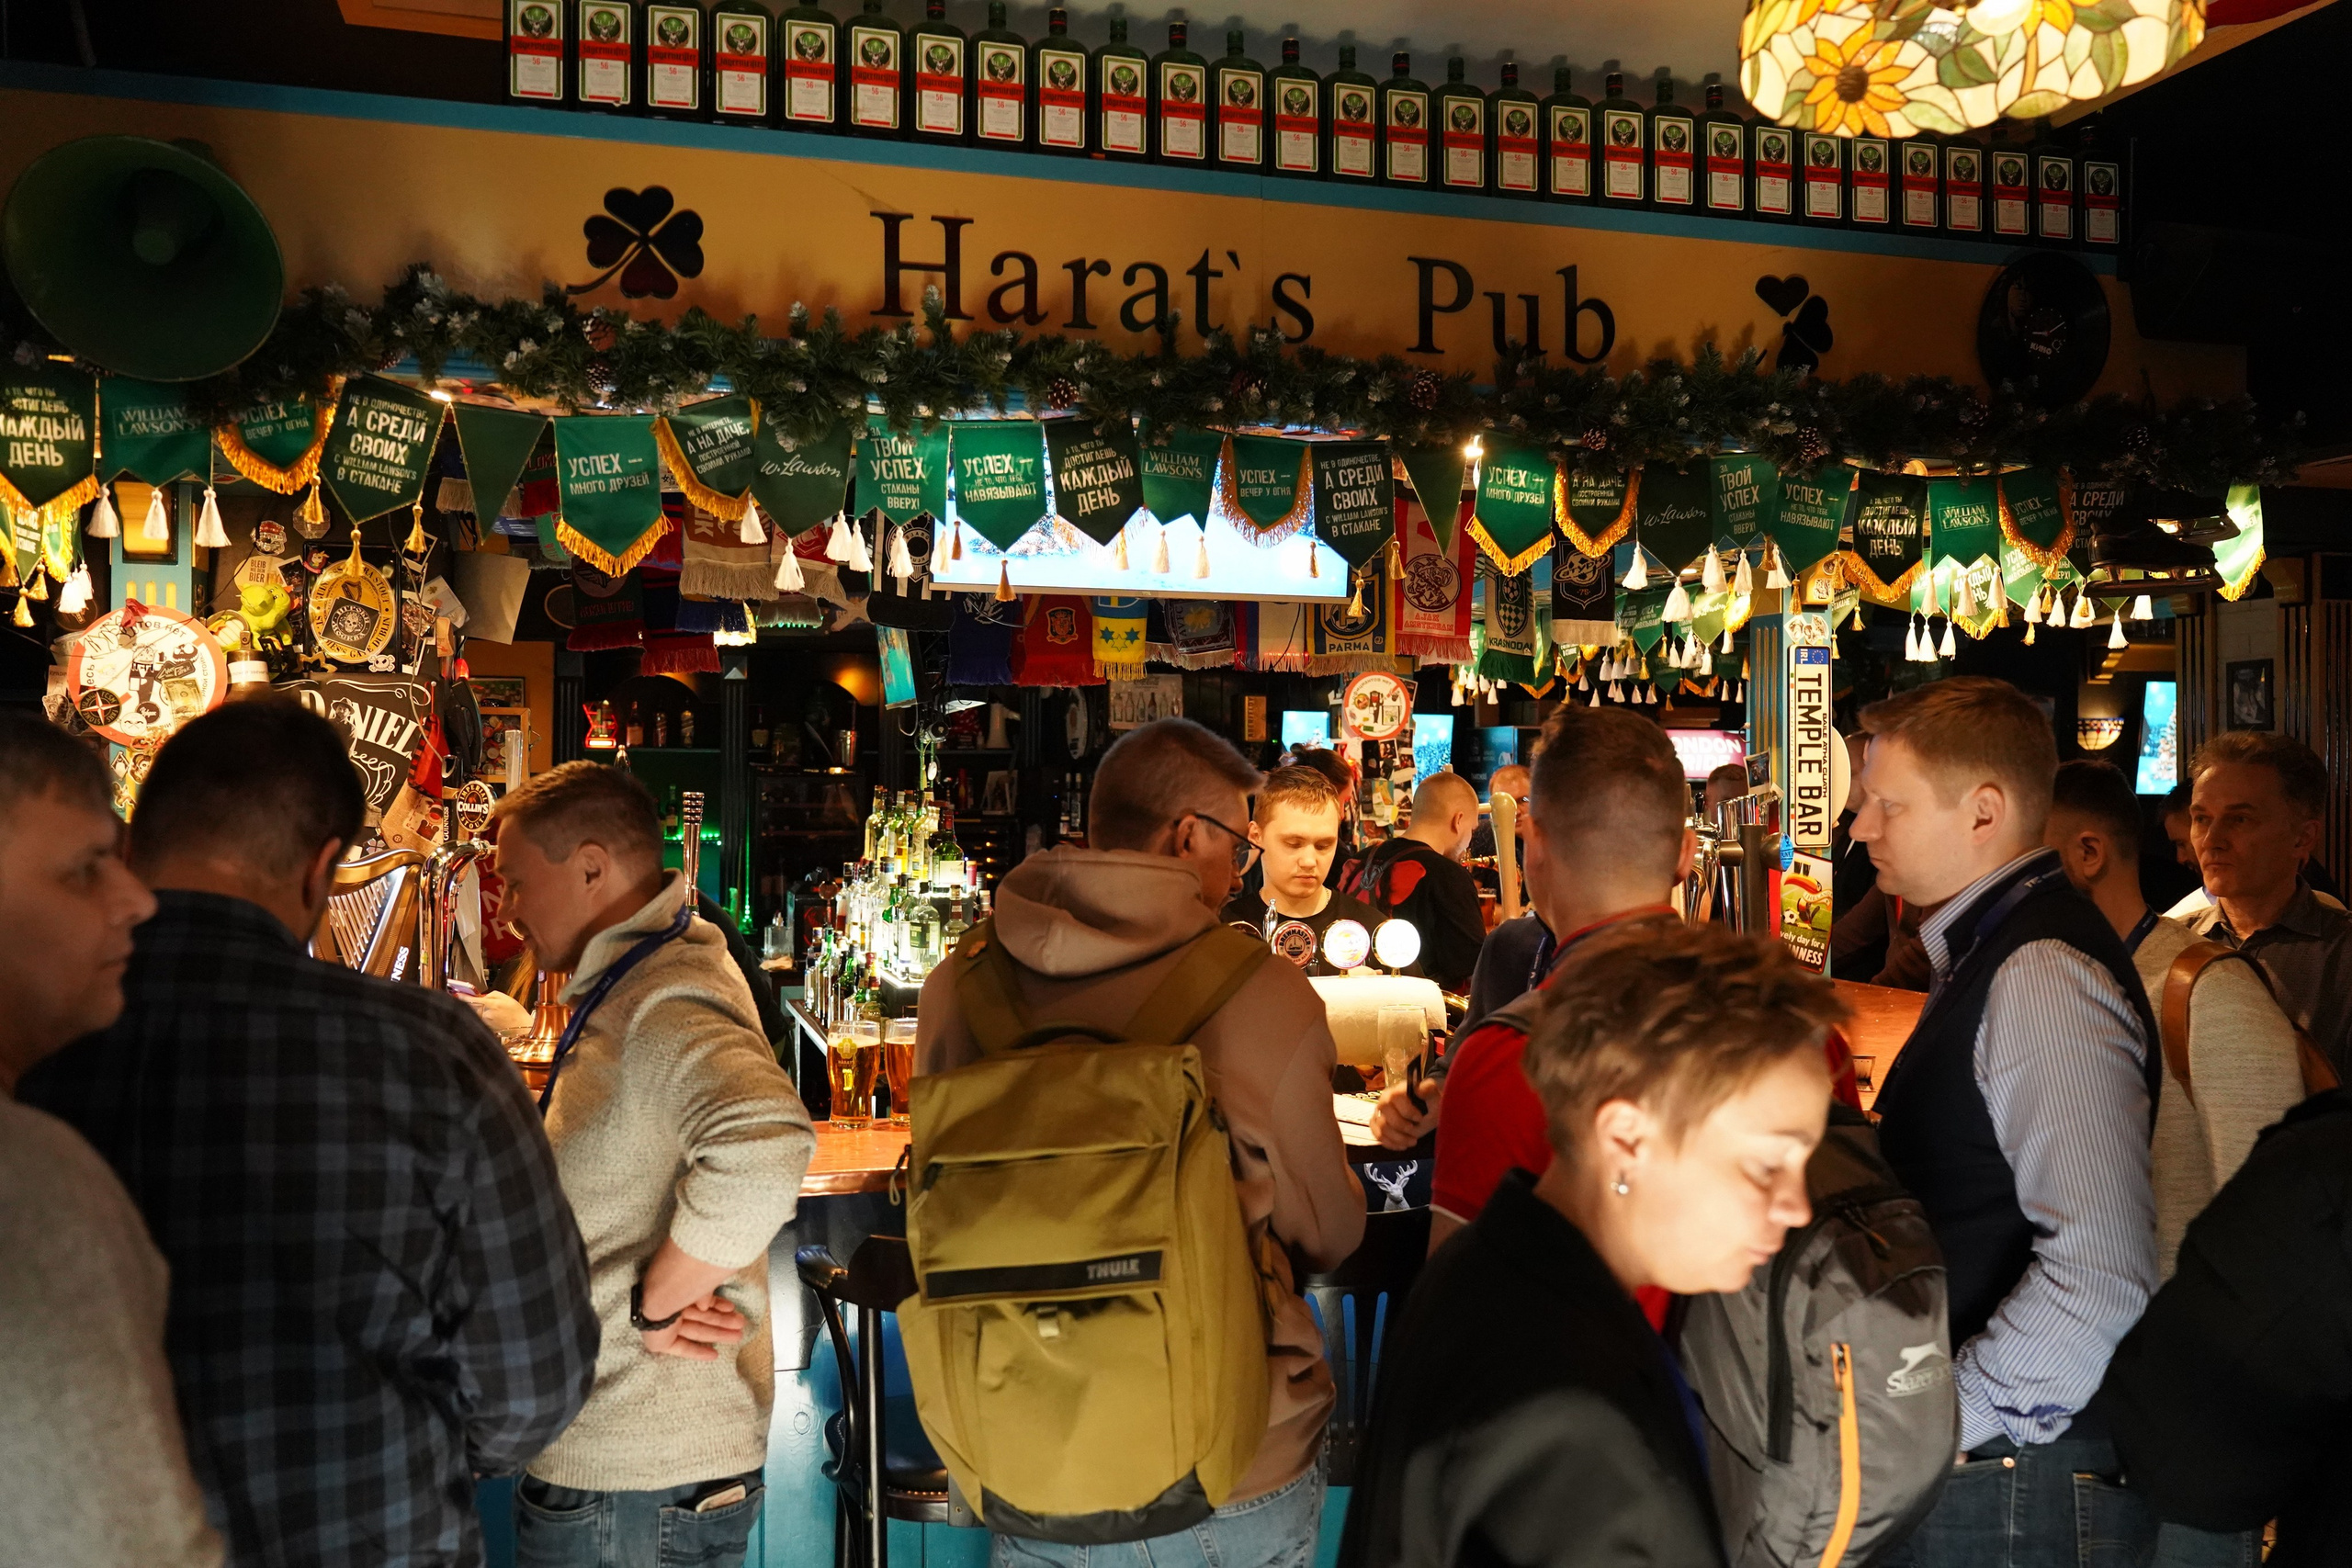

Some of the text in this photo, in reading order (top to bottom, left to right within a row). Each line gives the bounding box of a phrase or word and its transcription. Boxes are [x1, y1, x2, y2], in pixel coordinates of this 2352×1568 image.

[532, 57, 541, 65] 56
[600, 62, 609, 70] 56
[1408, 255, 1620, 365] Pub
[346, 406, 427, 443] А СРЕДИ
[870, 427, 881, 436] ЗА
[686, 422, 751, 455] А НА ДАЧЕ,
[1080, 441, 1095, 450] ЧЕГО
[8, 442, 64, 468] ДЕНЬ
[349, 433, 408, 466] СВОИХ
[698, 440, 741, 462] ПОСТРОЕННОЙ
[1064, 447, 1117, 470] ДОСТИГАЕШЬ
[343, 455, 377, 471] WILLIAM
[379, 463, 417, 480] LAWSON'S
[568, 453, 623, 478] УСПЕХ
[696, 446, 753, 475] СВОИМИ РУКАМИ
[963, 453, 1013, 478] УСПЕХ
[1149, 450, 1200, 468] WILLIAM
[1320, 461, 1329, 469] НЕ
[870, 457, 926, 481] УСПЕХ
[1060, 455, 1134, 492] КАЖДЫЙ
[1145, 461, 1203, 479] LAWSON'S
[1239, 469, 1276, 484] УСПЕХ
[1325, 464, 1385, 490] А СРЕДИ
[1488, 466, 1527, 488] УСПЕХ
[1719, 465, 1728, 473] ЗА
[1719, 464, 1752, 491] ТВОЙ
[336, 467, 403, 494] В СТАКАНЕ
[570, 480, 606, 495] МНОГО
[609, 471, 650, 492] ДРУЗЕЙ
[881, 483, 920, 494] СТАКАНЫ
[975, 479, 983, 487] НЕ
[995, 476, 1007, 484] ЧТО
[965, 482, 1036, 502] НАВЯЗЫВАЮТ
[1240, 487, 1291, 497] ВЕЧЕР У ОГНЯ
[1332, 487, 1378, 511] СВОИХ
[1486, 487, 1545, 505] МНОГО ДРУЗЕЙ
[1720, 485, 1760, 513] УСПЕХ
[1785, 483, 1824, 506] УСПЕХ
[2083, 491, 2125, 508] СРЕДИ
[888, 497, 920, 510] ВВЕРХ!
[1077, 487, 1121, 517] ДЕНЬ
[1864, 506, 1909, 516] ДОСТИГАЕШЬ
[2011, 496, 2043, 515] УСПЕХ
[1331, 512, 1359, 523] WILLIAM
[1360, 506, 1388, 519] LAWSON'S
[1728, 509, 1755, 523] СТАКАНЫ
[1781, 511, 1836, 531] НАВЯЗЫВАЮТ
[1942, 513, 1990, 529] LAWSON'S
[1943, 505, 1985, 519] WILLIAM
[2018, 515, 2036, 526] ВЕЧЕР
[1331, 519, 1381, 538] В СТАКАНЕ
[1858, 515, 1917, 537] КАЖДЫЙ
[1870, 539, 1903, 557] ДЕНЬ
[250, 559, 266, 569] BLEIB
[249, 572, 265, 582] BIER
[372, 577, 390, 604] STOUT
[1404, 620, 1454, 631] AMSTERDAM
[1414, 613, 1440, 622] AJAX
[372, 616, 390, 650] DUBLIN
[1329, 642, 1370, 652] PARMA
[1800, 649, 1808, 664] IRL
[1671, 737, 1742, 753] ONDON
[1797, 673, 1822, 836] TEMPLE BAR
[459, 784, 488, 802] IMPERIAL
[460, 817, 484, 829] STOUT
[1279, 929, 1311, 946] BREWMASTER
[1780, 931, 1796, 942] vely
[1797, 934, 1810, 947] day
[1811, 938, 1820, 948] for
[1087, 1258, 1139, 1280] THULE
